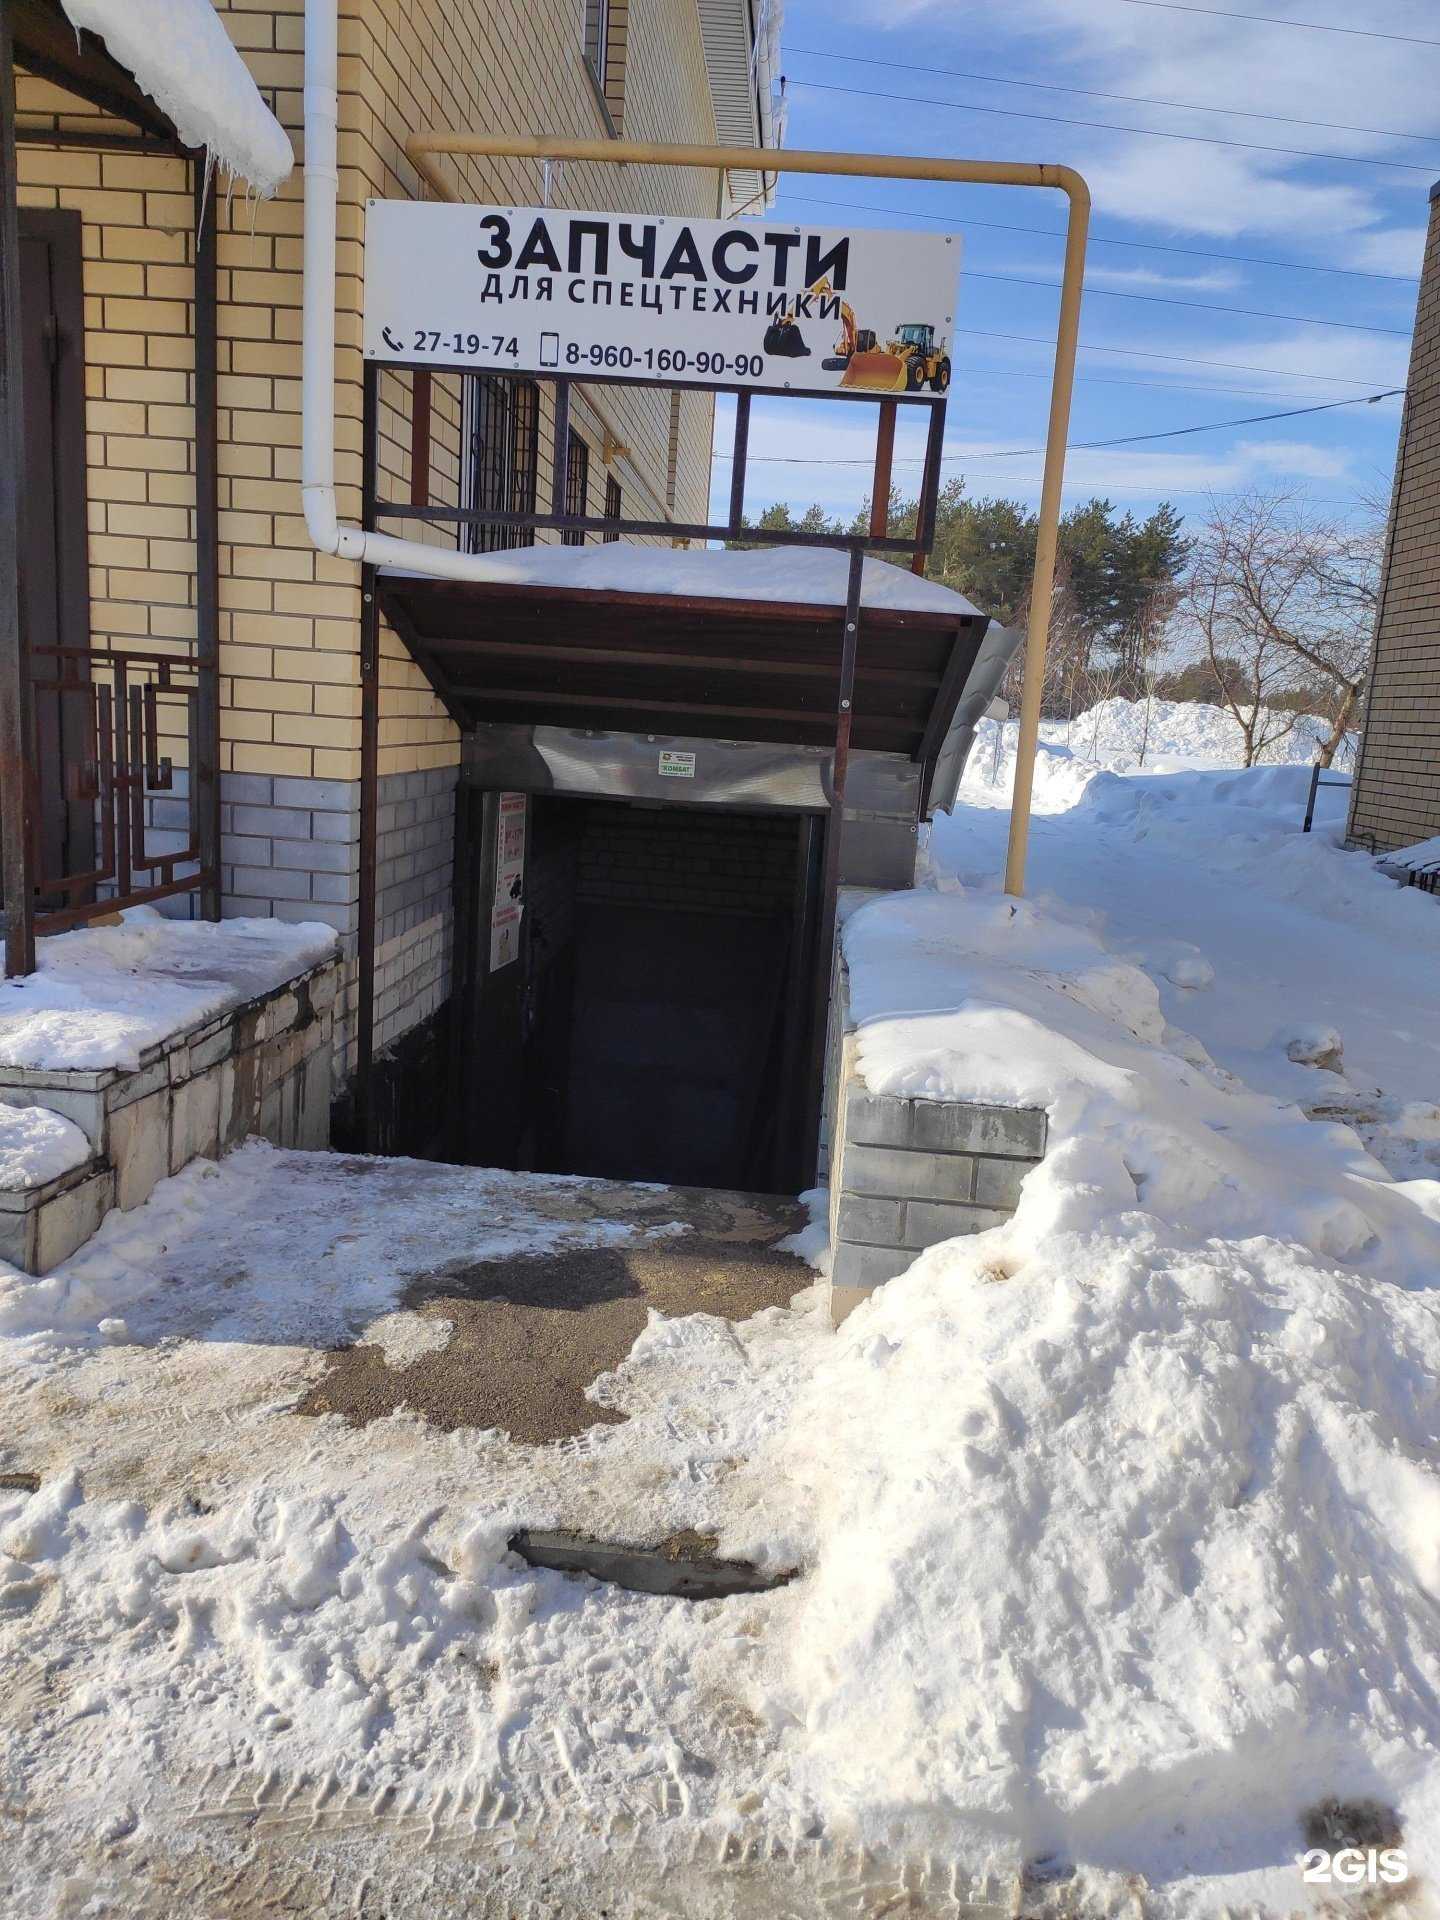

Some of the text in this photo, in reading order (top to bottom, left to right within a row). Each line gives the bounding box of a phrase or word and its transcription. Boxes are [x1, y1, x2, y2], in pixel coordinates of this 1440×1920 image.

[477, 213, 850, 291] ЗАПЧАСТИ
[481, 273, 842, 321] ДЛЯ СПЕЦТЕХНИКИ
[414, 330, 519, 358] 27-19-74
[565, 342, 764, 378] 8-960-160-90-90
